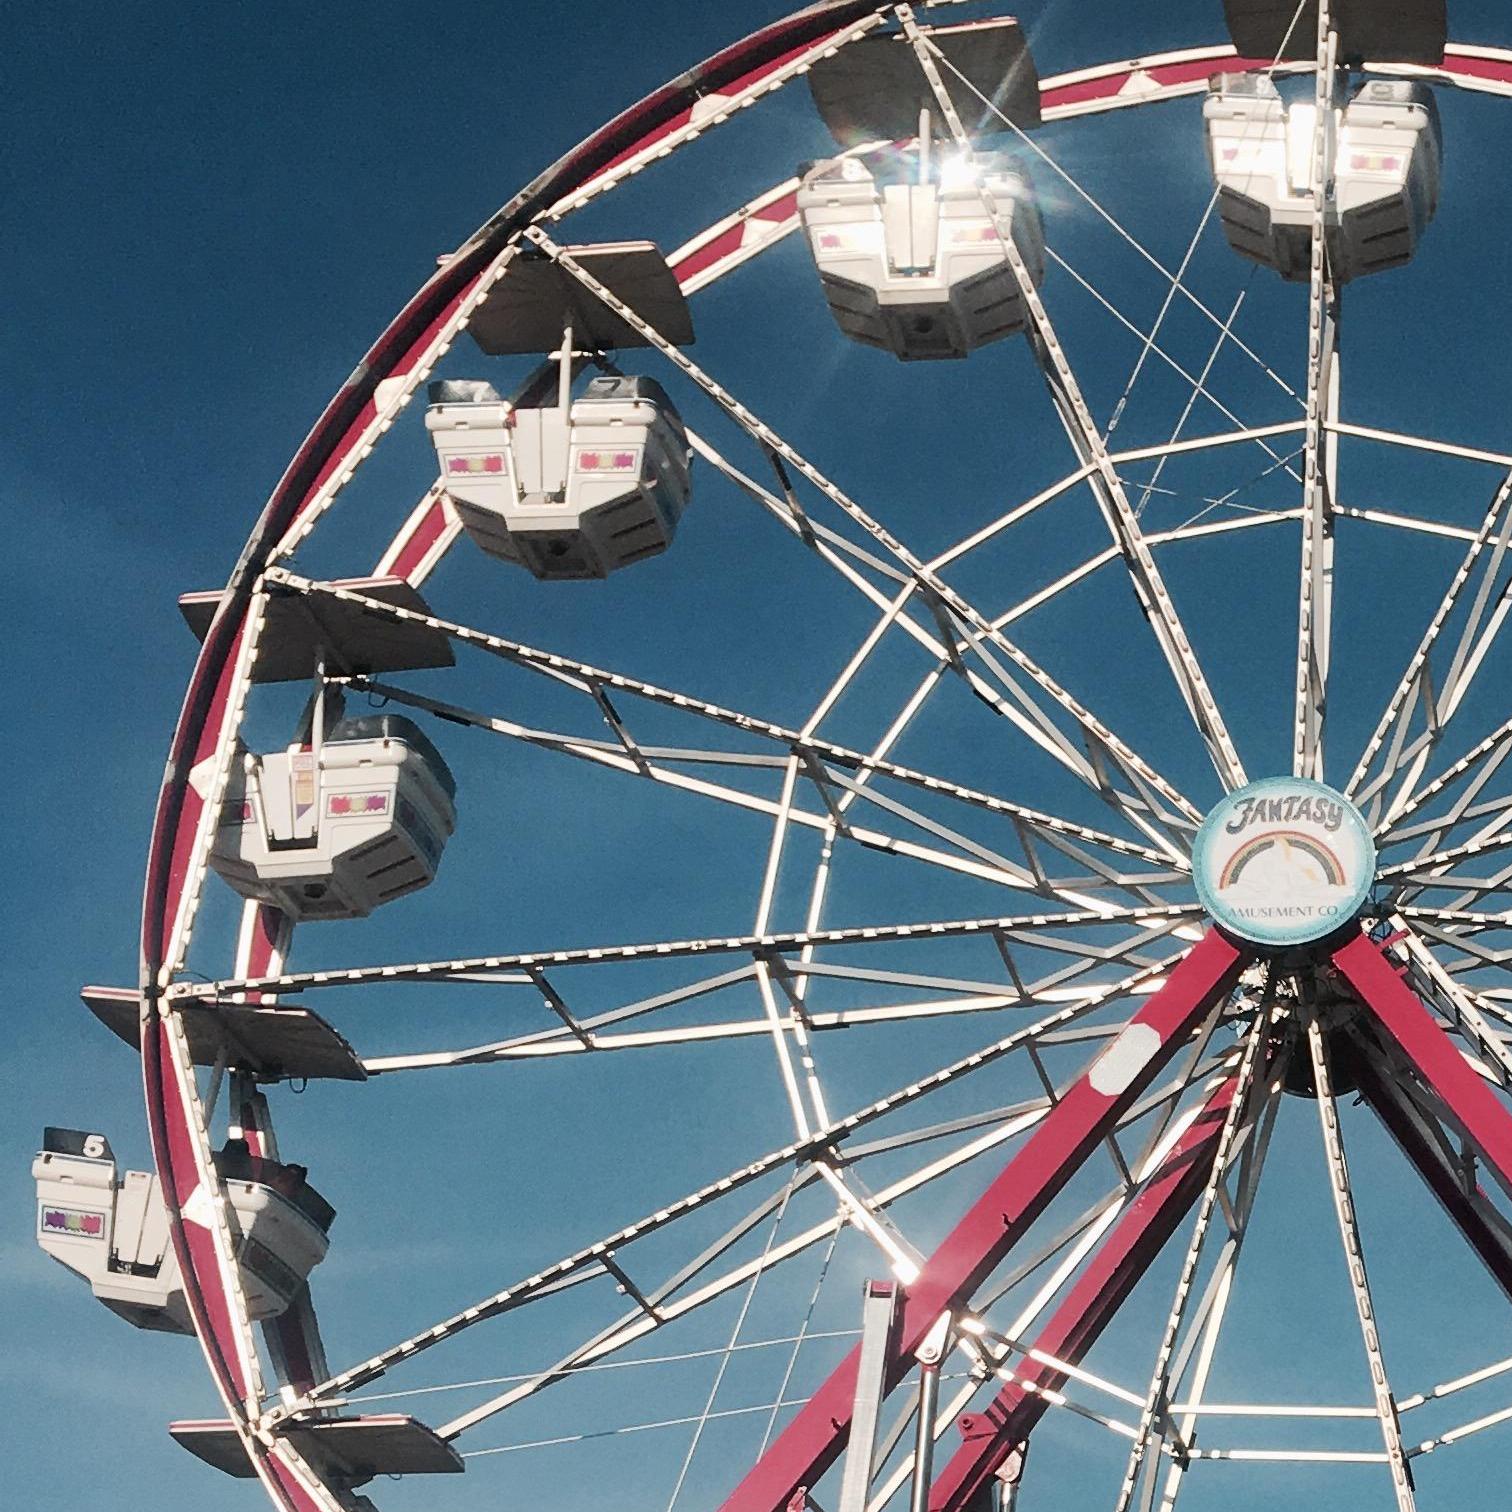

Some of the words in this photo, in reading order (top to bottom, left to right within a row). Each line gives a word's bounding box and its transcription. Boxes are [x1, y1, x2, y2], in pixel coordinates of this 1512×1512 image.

[1225, 796, 1344, 834] FANTASY
[1228, 906, 1314, 918] AMUSEMENT
[83, 1134, 105, 1158] 5
